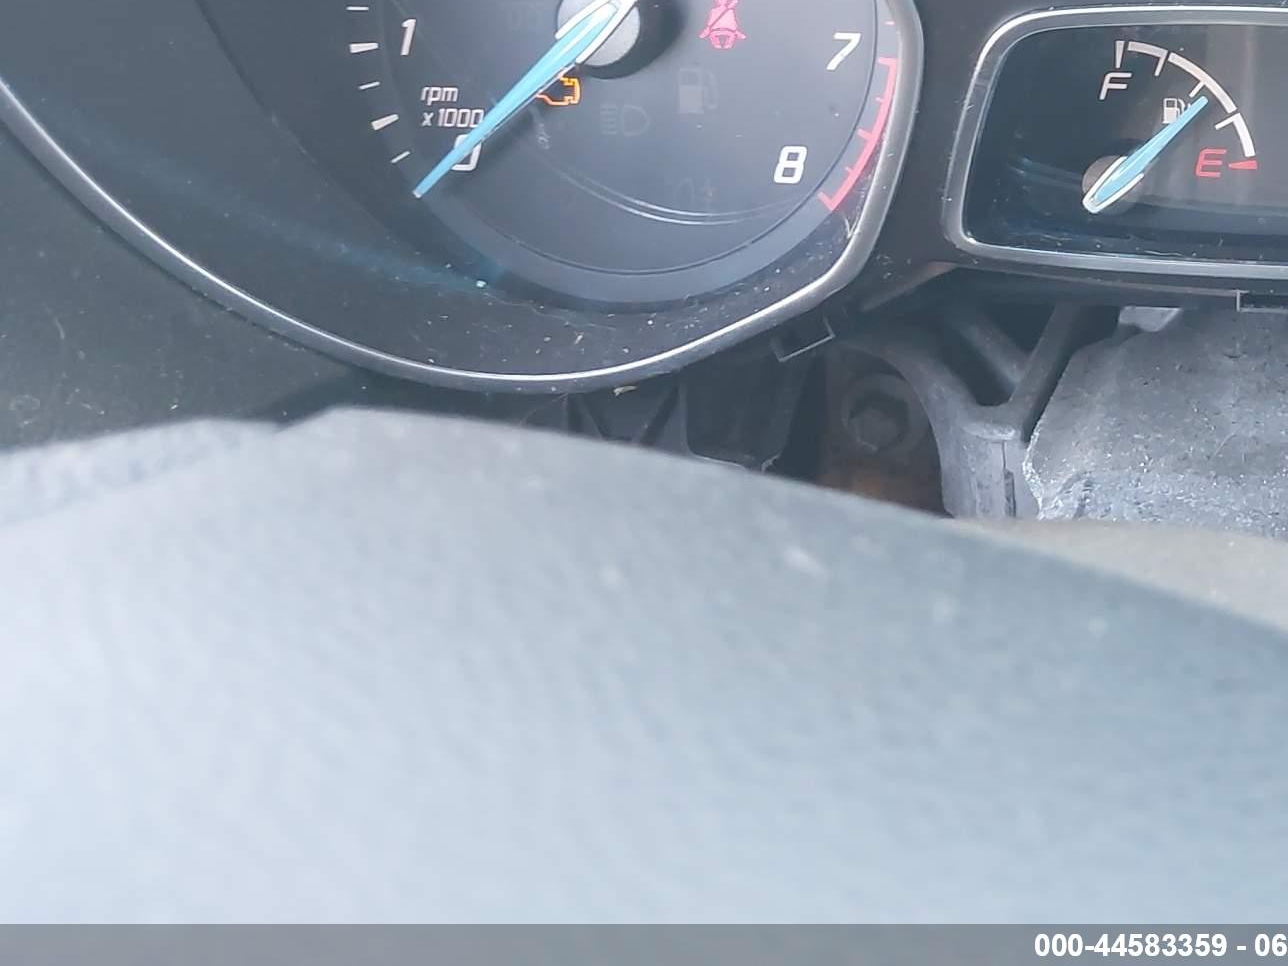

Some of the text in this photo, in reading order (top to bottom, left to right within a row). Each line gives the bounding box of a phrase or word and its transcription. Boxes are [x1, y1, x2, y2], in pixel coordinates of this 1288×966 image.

[400, 19, 417, 56] 1
[826, 32, 861, 70] 7
[420, 86, 459, 106] rpm
[1099, 72, 1133, 101] F
[438, 108, 484, 127] 1000
[773, 146, 807, 183] 8
[1195, 148, 1227, 177] E
